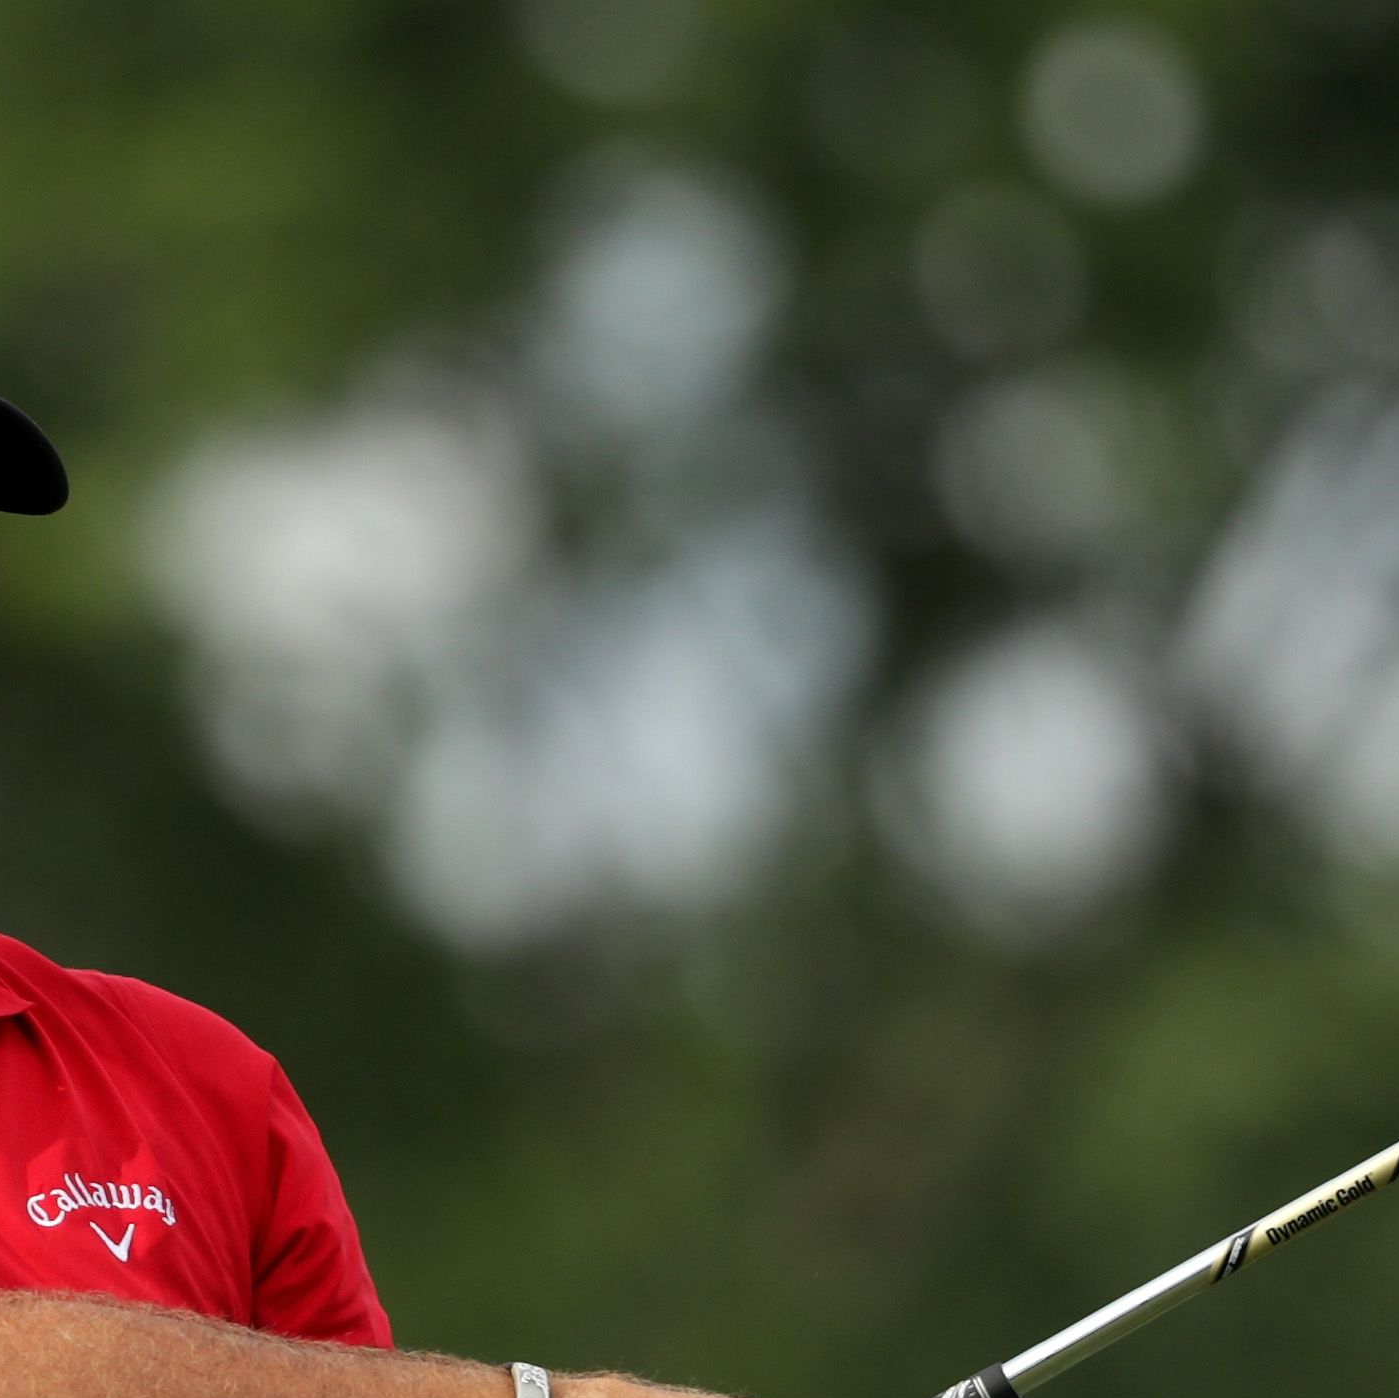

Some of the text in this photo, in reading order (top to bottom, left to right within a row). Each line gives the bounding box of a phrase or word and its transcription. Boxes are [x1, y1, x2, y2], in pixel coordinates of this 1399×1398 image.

[26, 1172, 177, 1227] Callaway
[1265, 1174, 1376, 1246] Dynamic Gold
